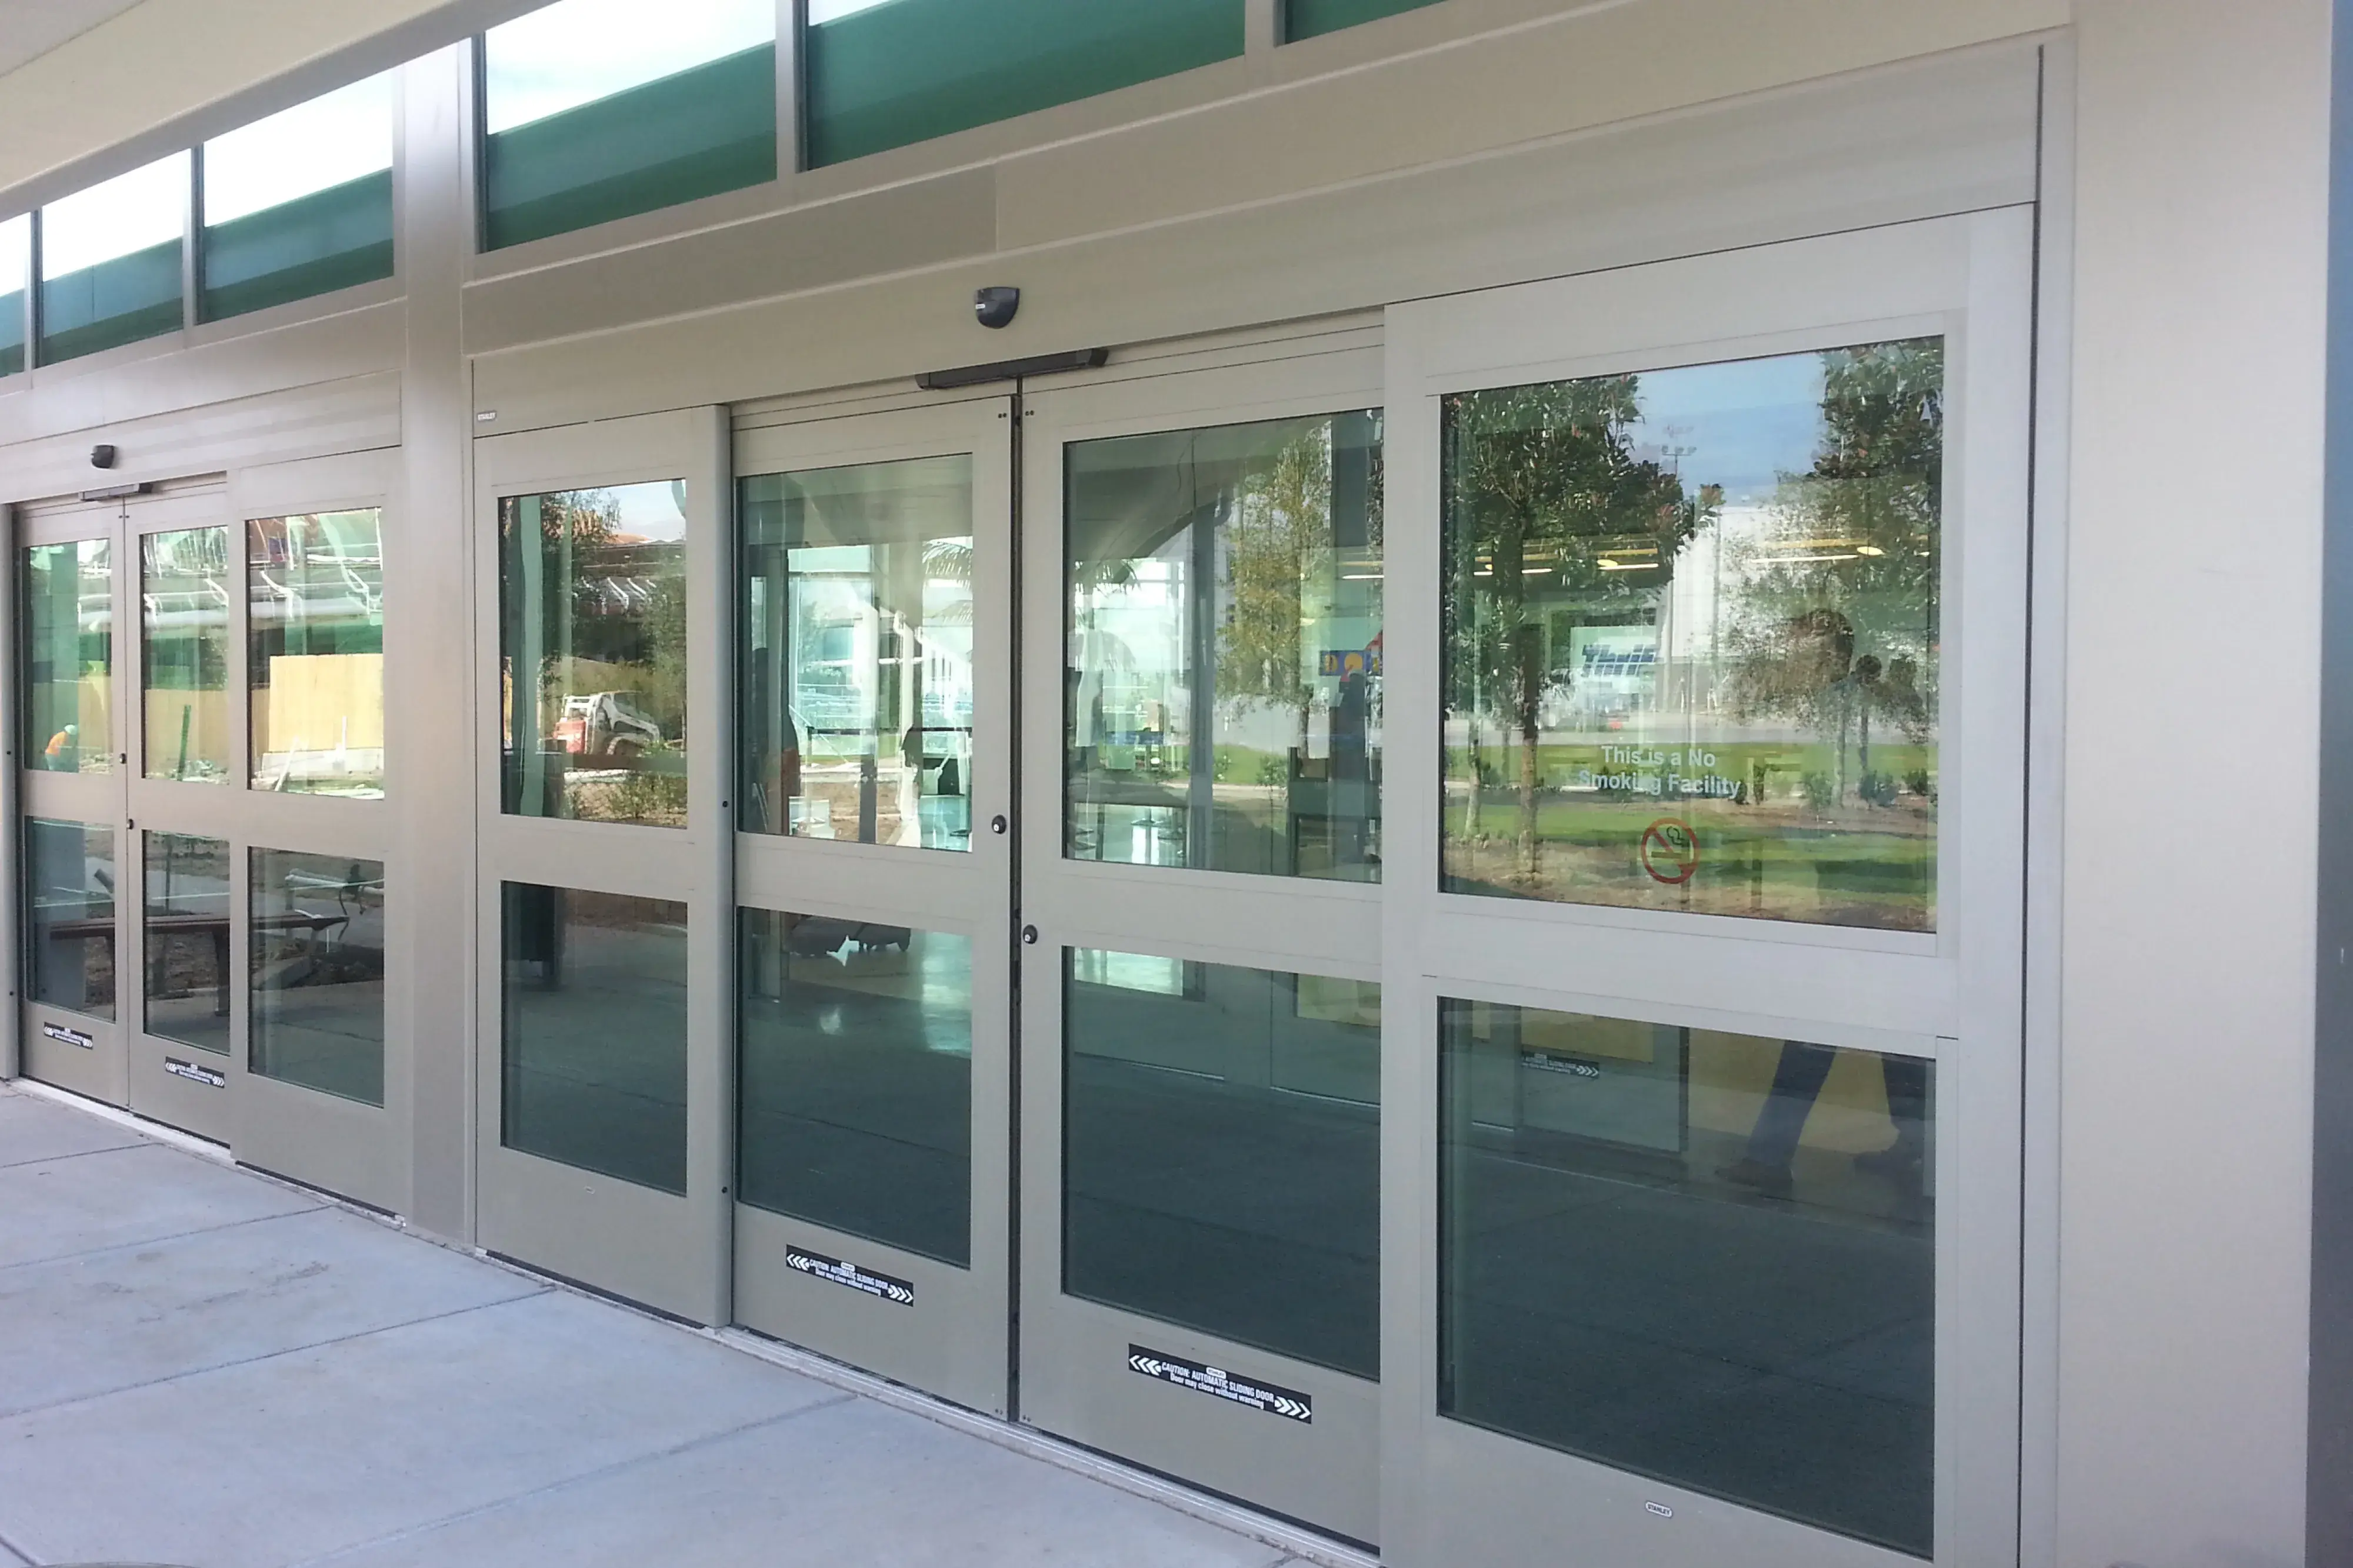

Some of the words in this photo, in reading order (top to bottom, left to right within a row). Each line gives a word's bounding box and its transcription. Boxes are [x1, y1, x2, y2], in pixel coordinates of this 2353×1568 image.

[1601, 745, 1642, 765] This
[1648, 749, 1664, 765] is
[1671, 752, 1681, 766] a
[1688, 748, 1715, 768] No
[1579, 769, 1662, 795] Smokig
[1668, 773, 1741, 799] Facility
[1191, 1370, 1228, 1389] AUTOMATIC
[1229, 1382, 1255, 1397] SLIDING
[1255, 1389, 1274, 1403] DOOR
